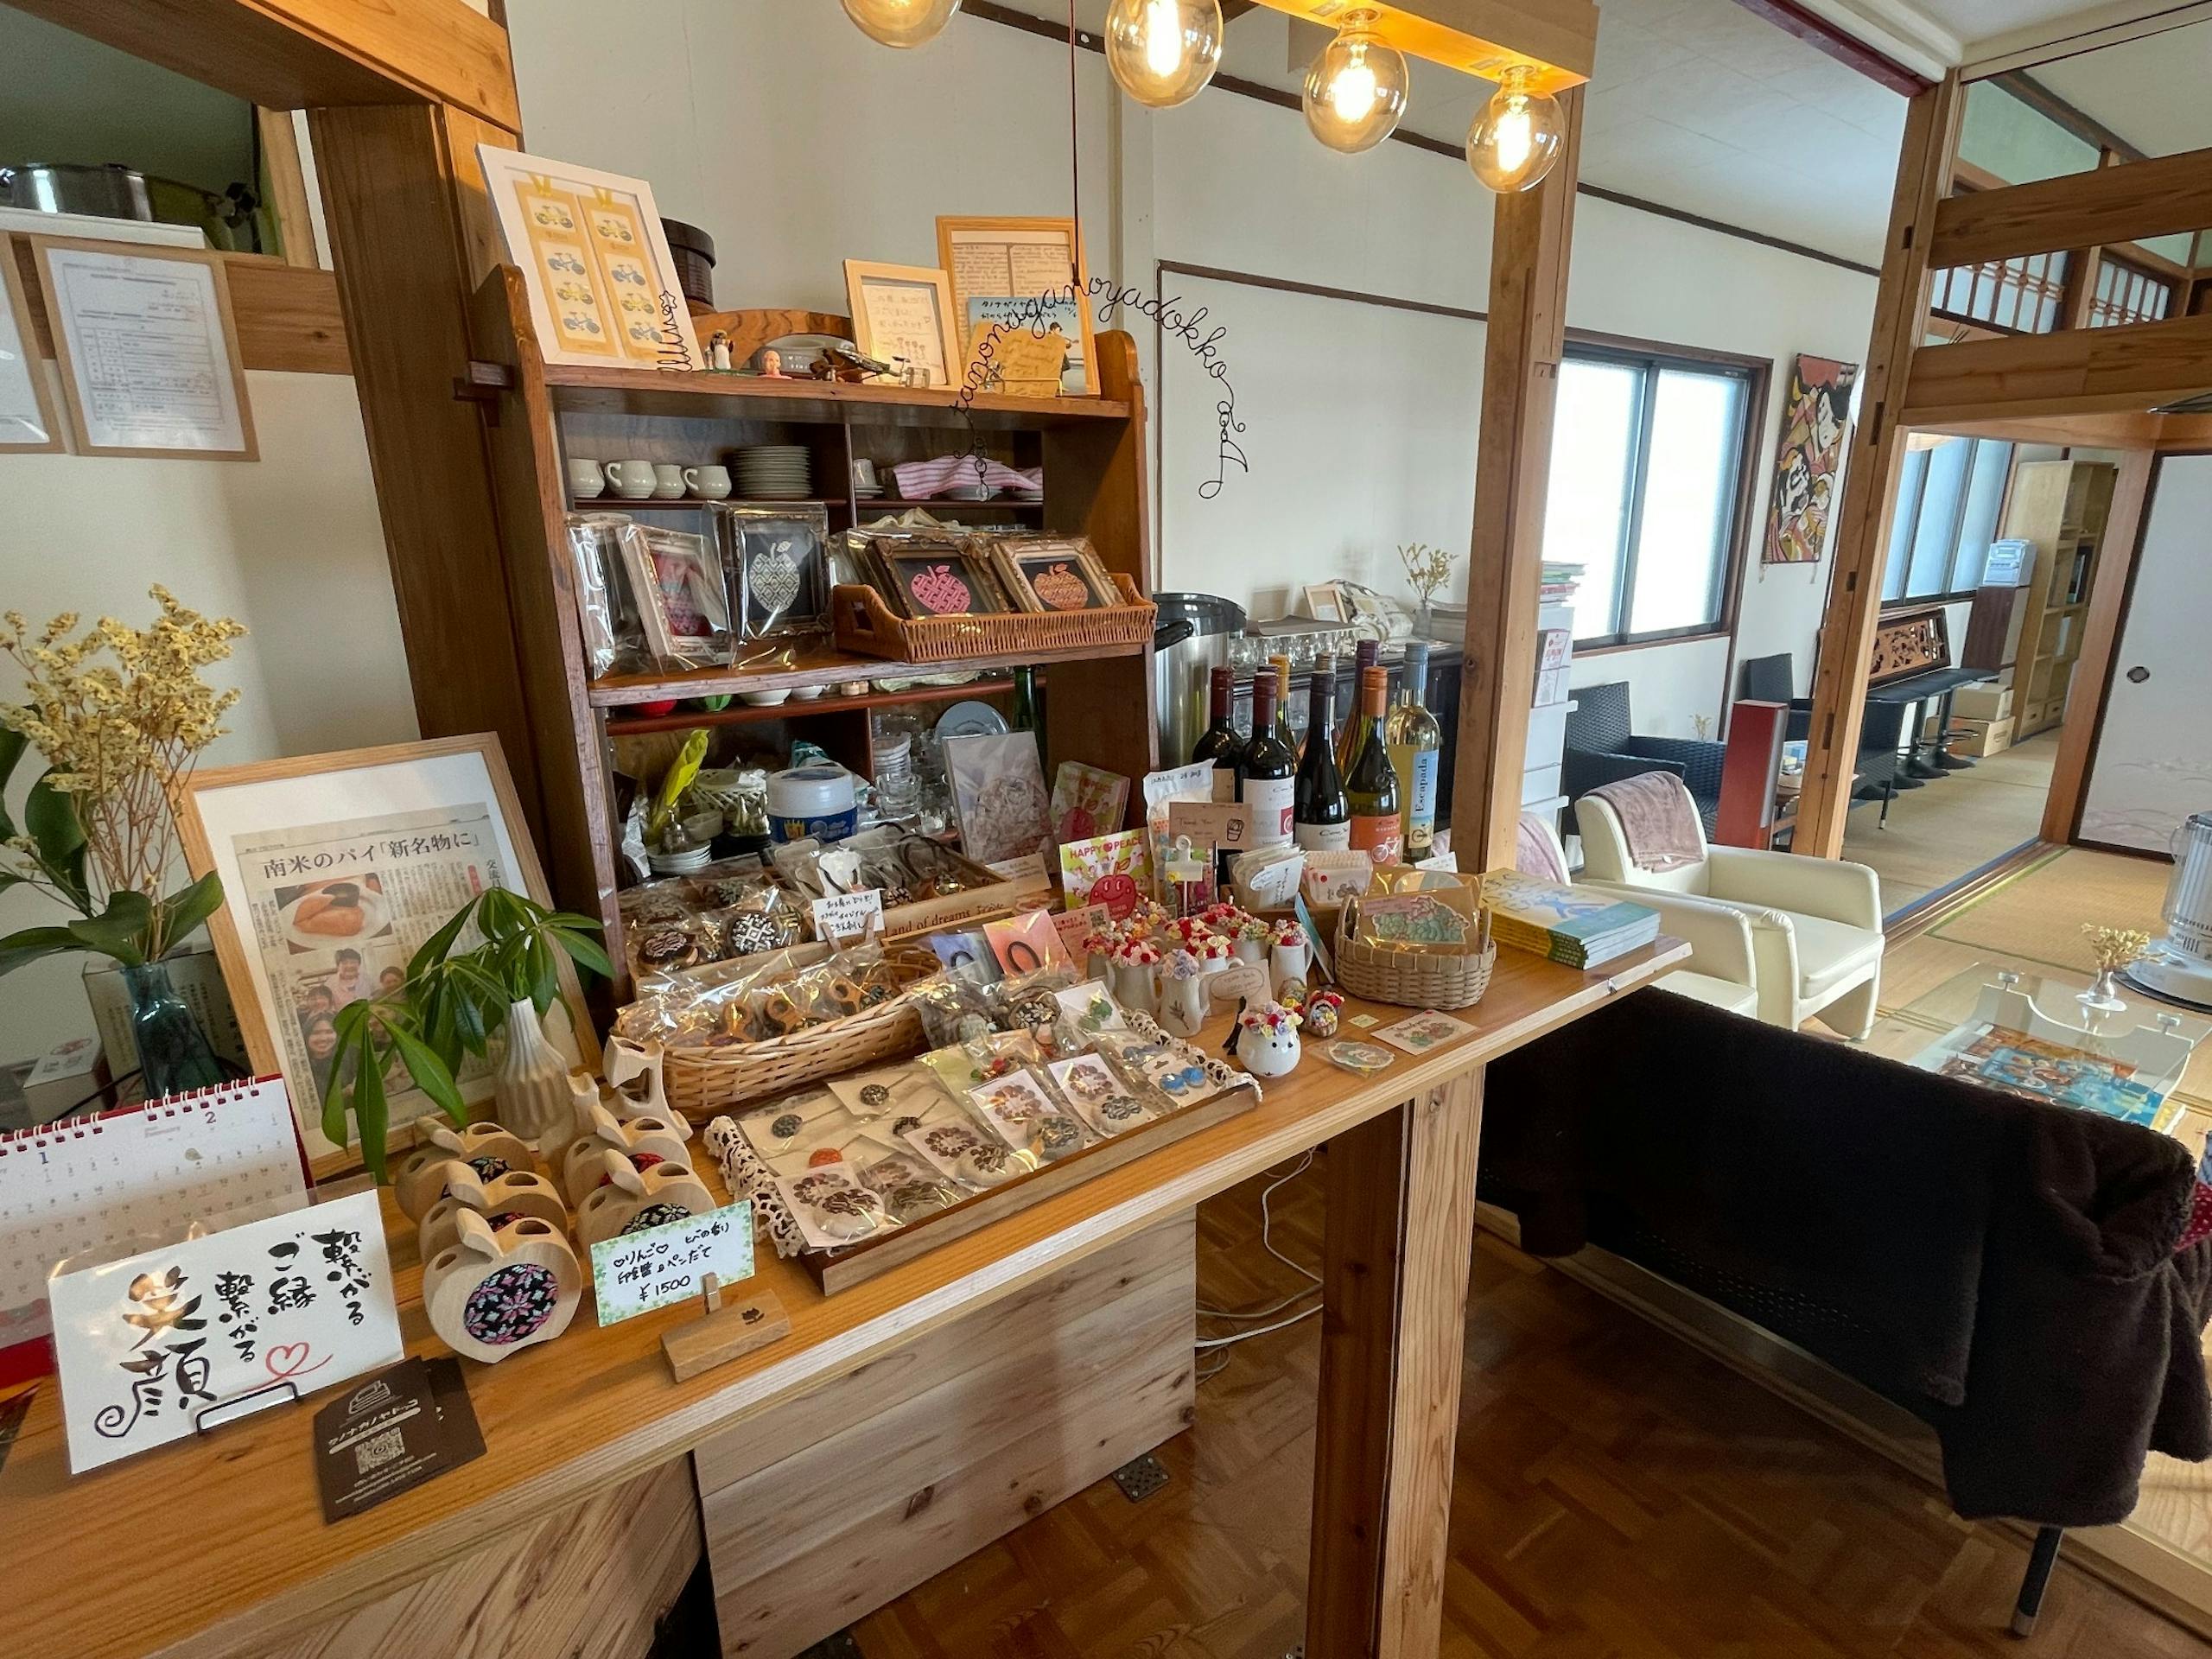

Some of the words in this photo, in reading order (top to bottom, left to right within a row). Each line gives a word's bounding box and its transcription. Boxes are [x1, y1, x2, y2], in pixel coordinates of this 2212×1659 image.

[1415, 759, 1428, 811] Escapada
[264, 831, 480, 879] 南米のパイ「新名物に」
[1070, 844, 1103, 859] HAPPY
[1114, 836, 1143, 850] PEACE
[916, 916, 929, 931] of
[932, 909, 970, 926] dreams
[205, 1111, 217, 1123] 2
[38, 1151, 49, 1165] 1
[267, 1232, 316, 1315] ご縁
[214, 1271, 259, 1363] 繋がる
[94, 1265, 217, 1438] 笑顔
